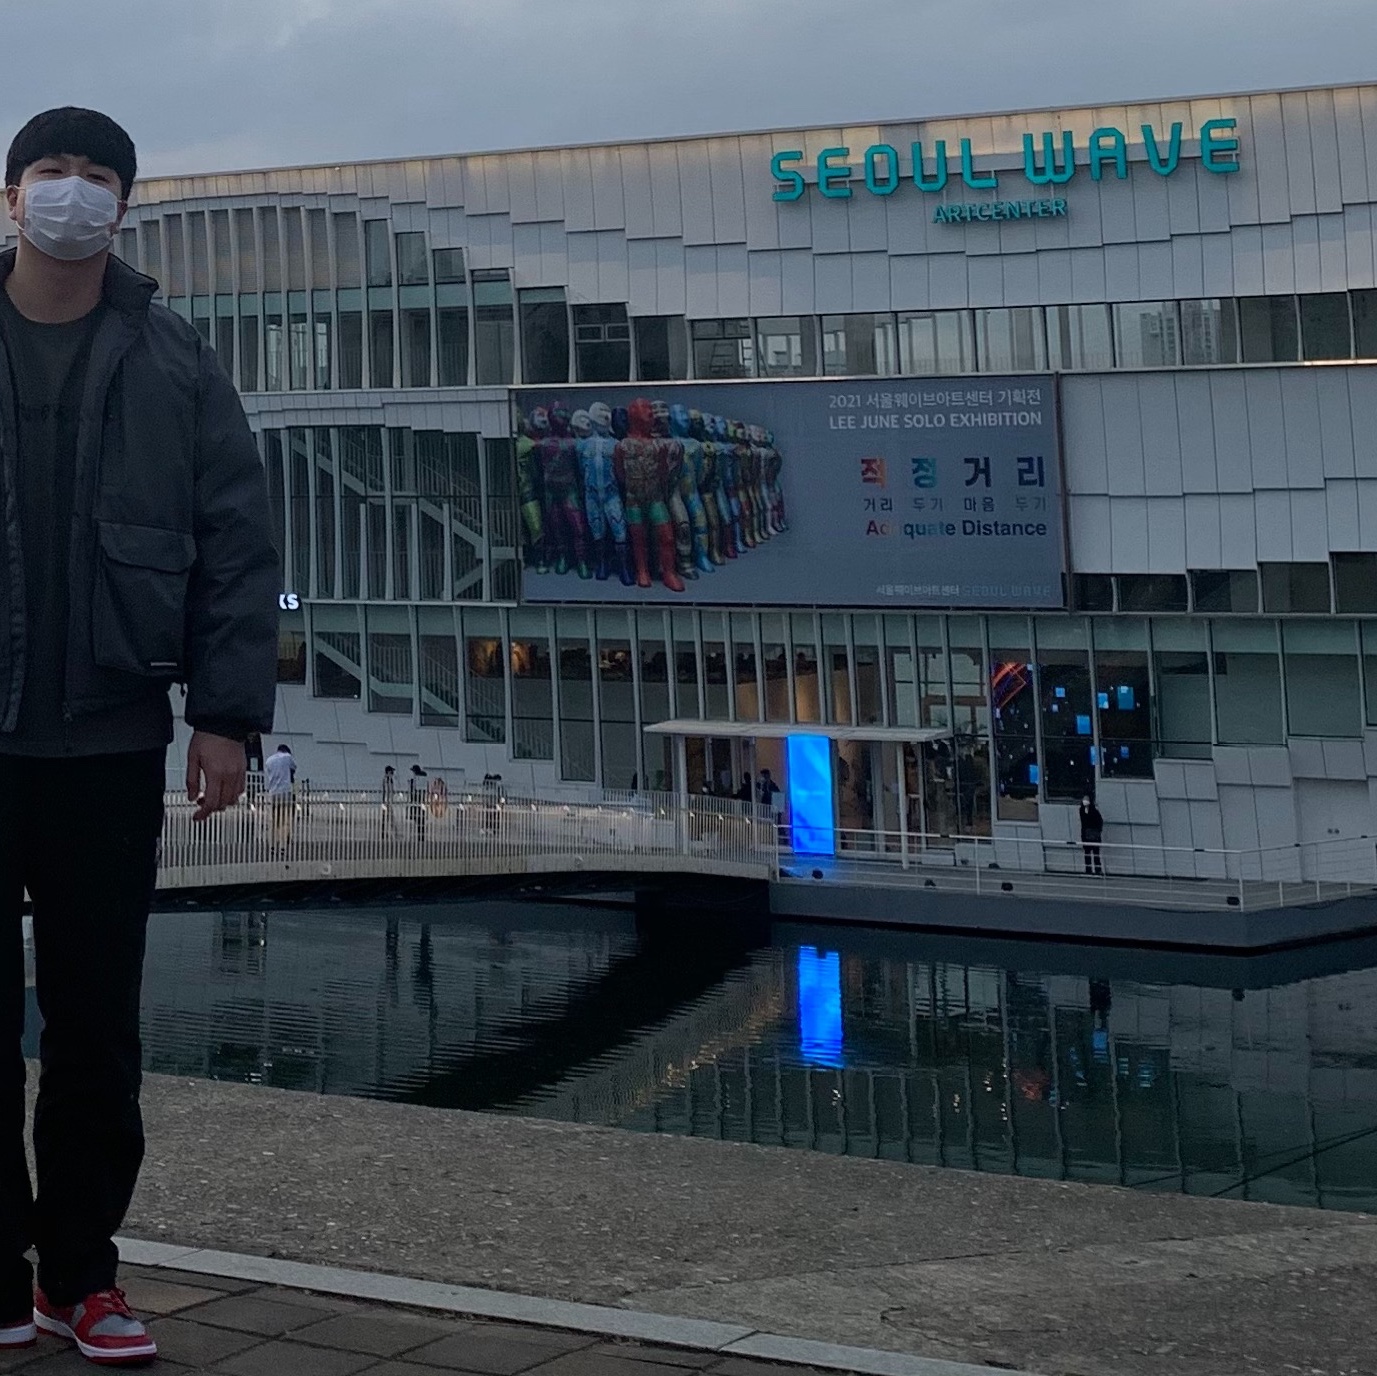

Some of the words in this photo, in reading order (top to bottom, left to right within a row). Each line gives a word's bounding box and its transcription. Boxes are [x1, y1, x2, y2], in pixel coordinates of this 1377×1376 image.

[771, 137, 998, 201] SEOUL
[1023, 118, 1240, 185] WAVE
[829, 395, 861, 409] 2021
[866, 390, 993, 409] 서울웨이브아트센터
[998, 388, 1041, 406] 기획전
[829, 415, 856, 430] LEE
[860, 414, 900, 429] JUNE
[904, 413, 945, 428] SOLO
[950, 411, 1042, 427] EXHIBITION
[963, 520, 1046, 536] Distance
